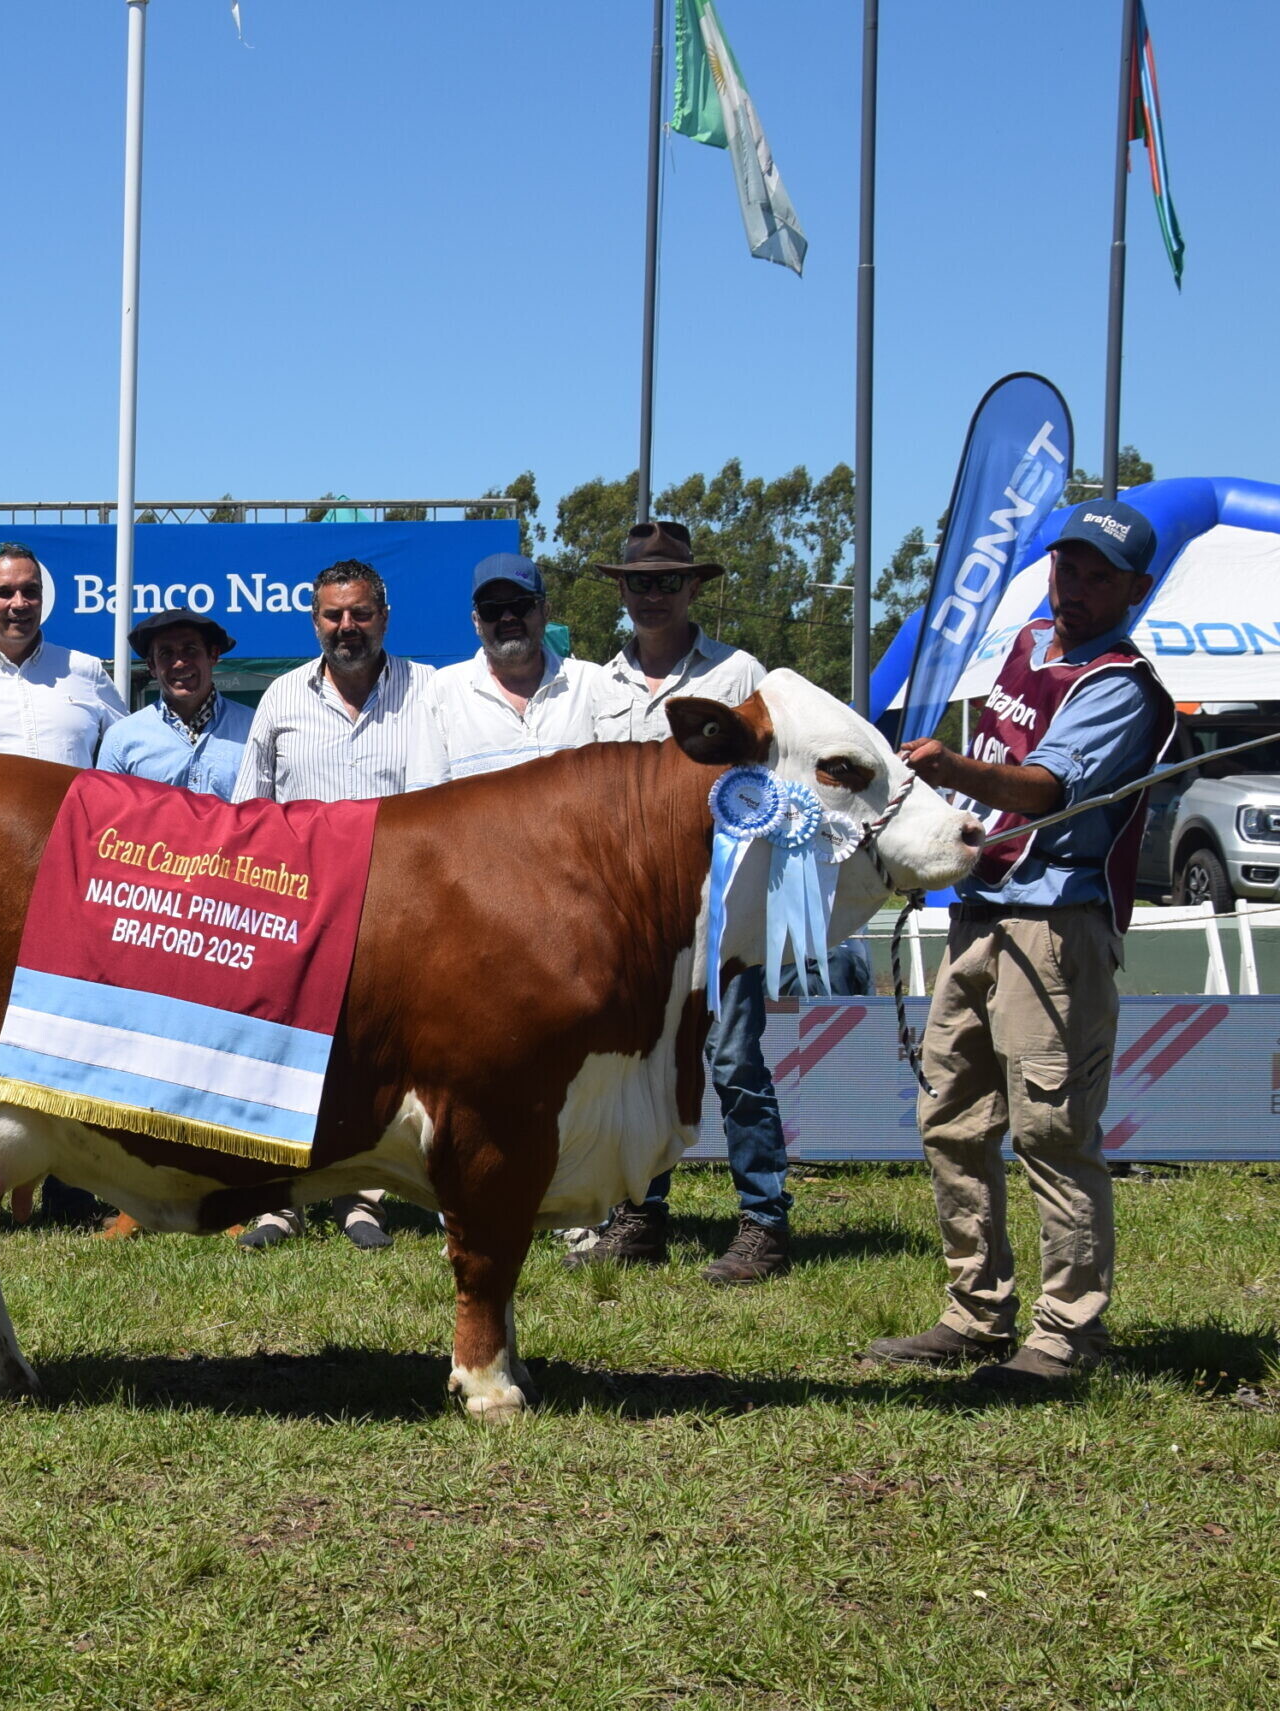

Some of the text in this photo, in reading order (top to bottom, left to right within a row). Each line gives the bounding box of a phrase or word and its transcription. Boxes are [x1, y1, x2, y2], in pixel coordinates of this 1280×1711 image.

[1083, 512, 1131, 536] Braford
[985, 684, 1037, 730] Brafor
[98, 827, 309, 900] Gran Campeón Hembra
[85, 878, 299, 945] NACIONAL PRIMAVERA
[112, 917, 256, 971] BRAFORD 2025
